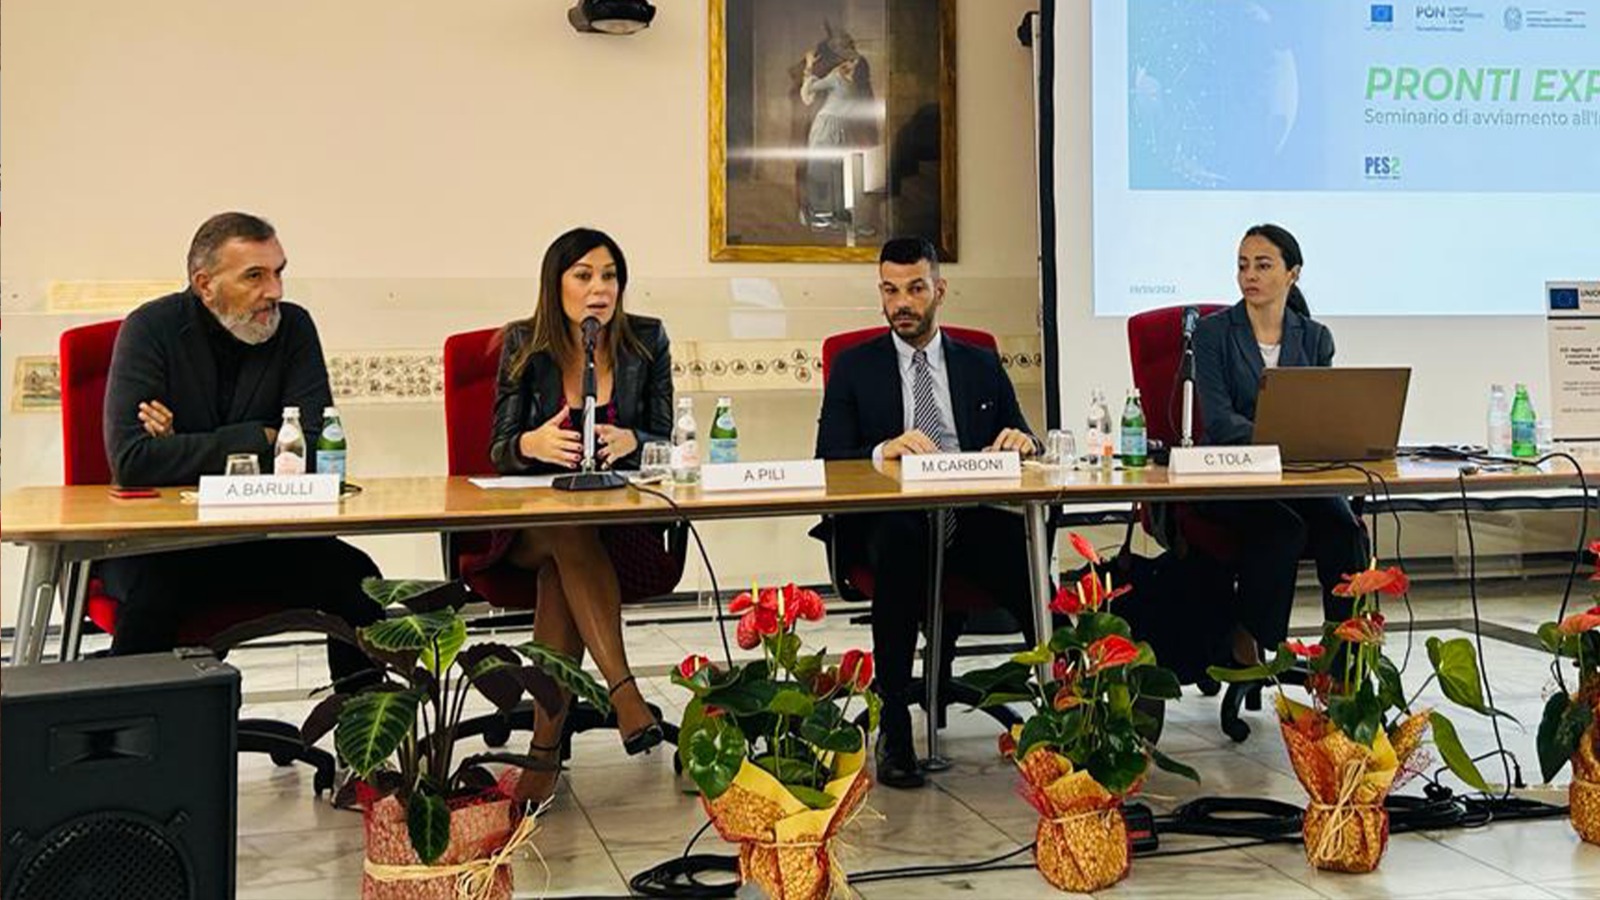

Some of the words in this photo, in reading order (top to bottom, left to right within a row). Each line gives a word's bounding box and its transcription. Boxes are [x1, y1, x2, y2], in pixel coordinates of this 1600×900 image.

[1416, 4, 1445, 19] PON
[1365, 66, 1520, 101] PRONTI
[1364, 108, 1449, 126] Seminario
[1453, 109, 1468, 126] di
[1472, 110, 1568, 126] avviamento
[1364, 156, 1401, 175] PES2
